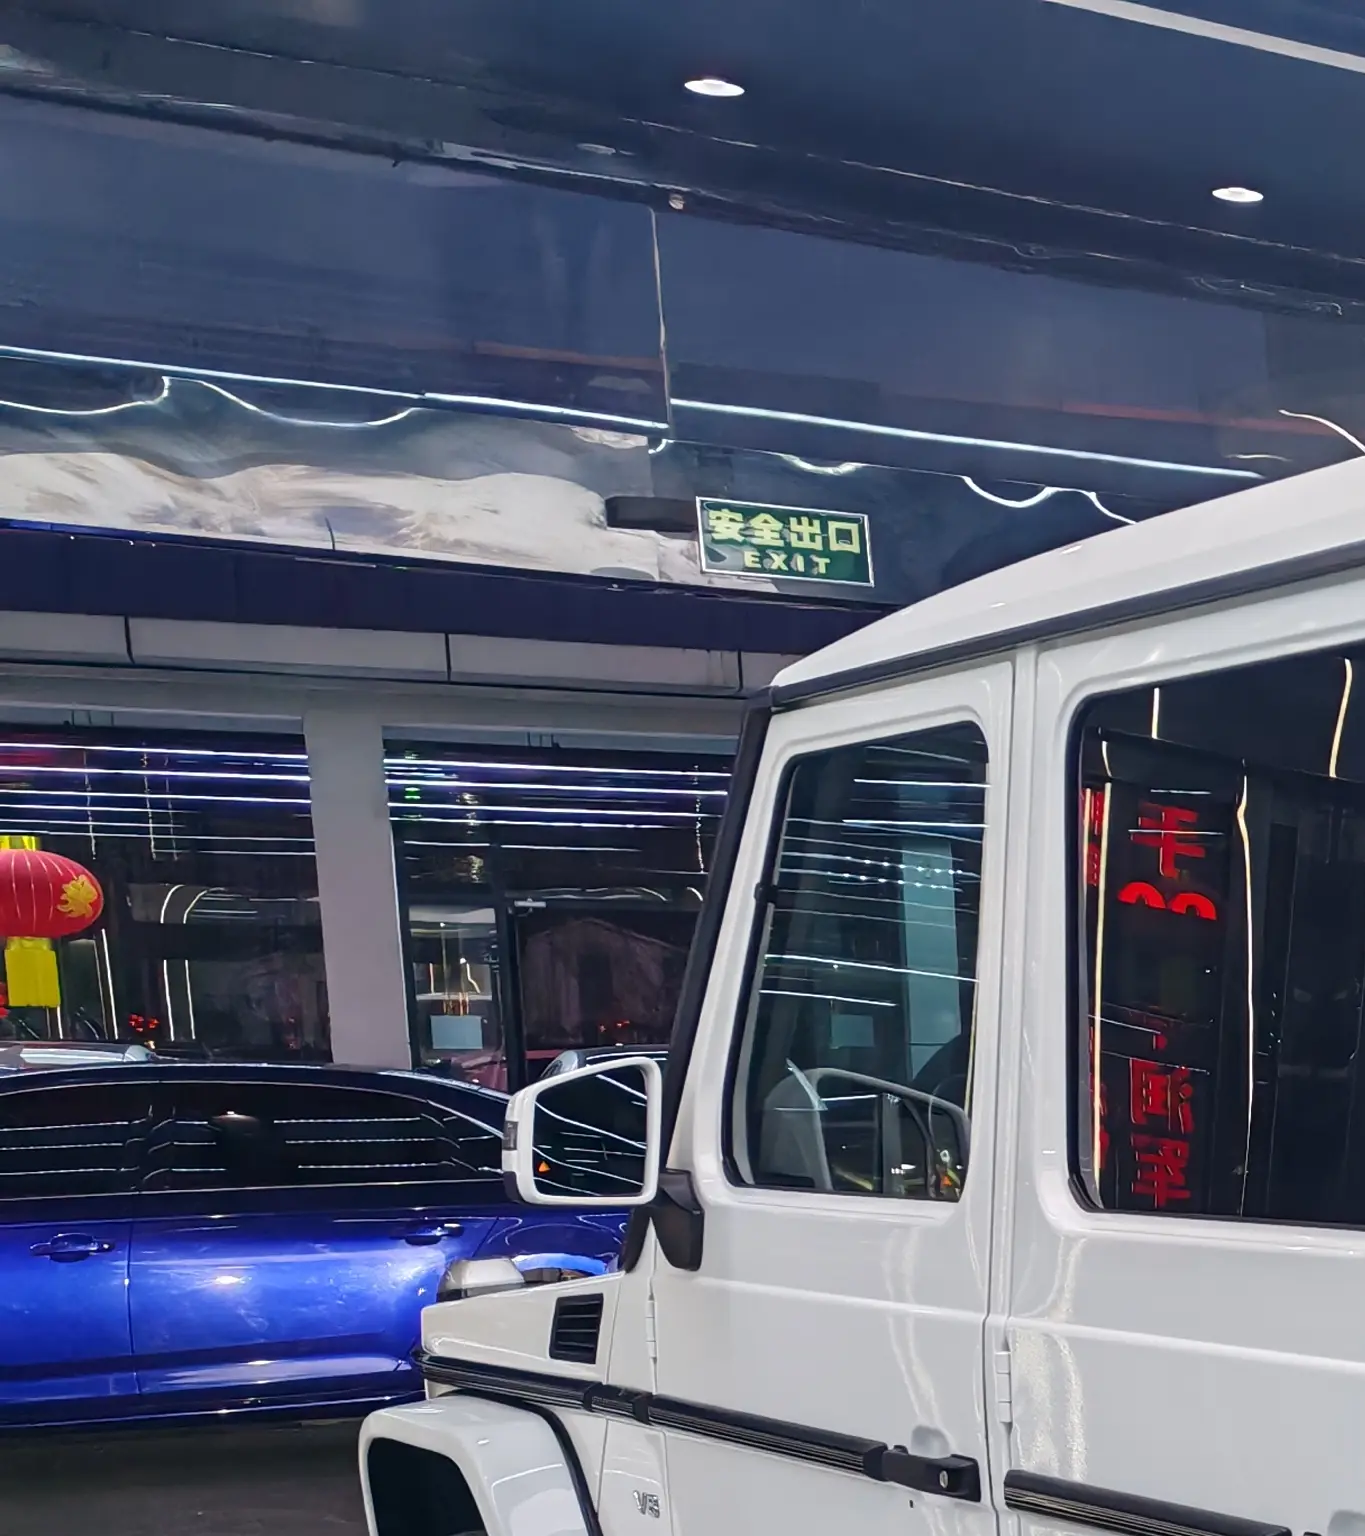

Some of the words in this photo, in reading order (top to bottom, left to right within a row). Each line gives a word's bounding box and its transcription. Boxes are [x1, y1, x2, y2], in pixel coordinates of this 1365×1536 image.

[708, 508, 861, 554] 安全出口
[743, 551, 831, 575] EXIT
